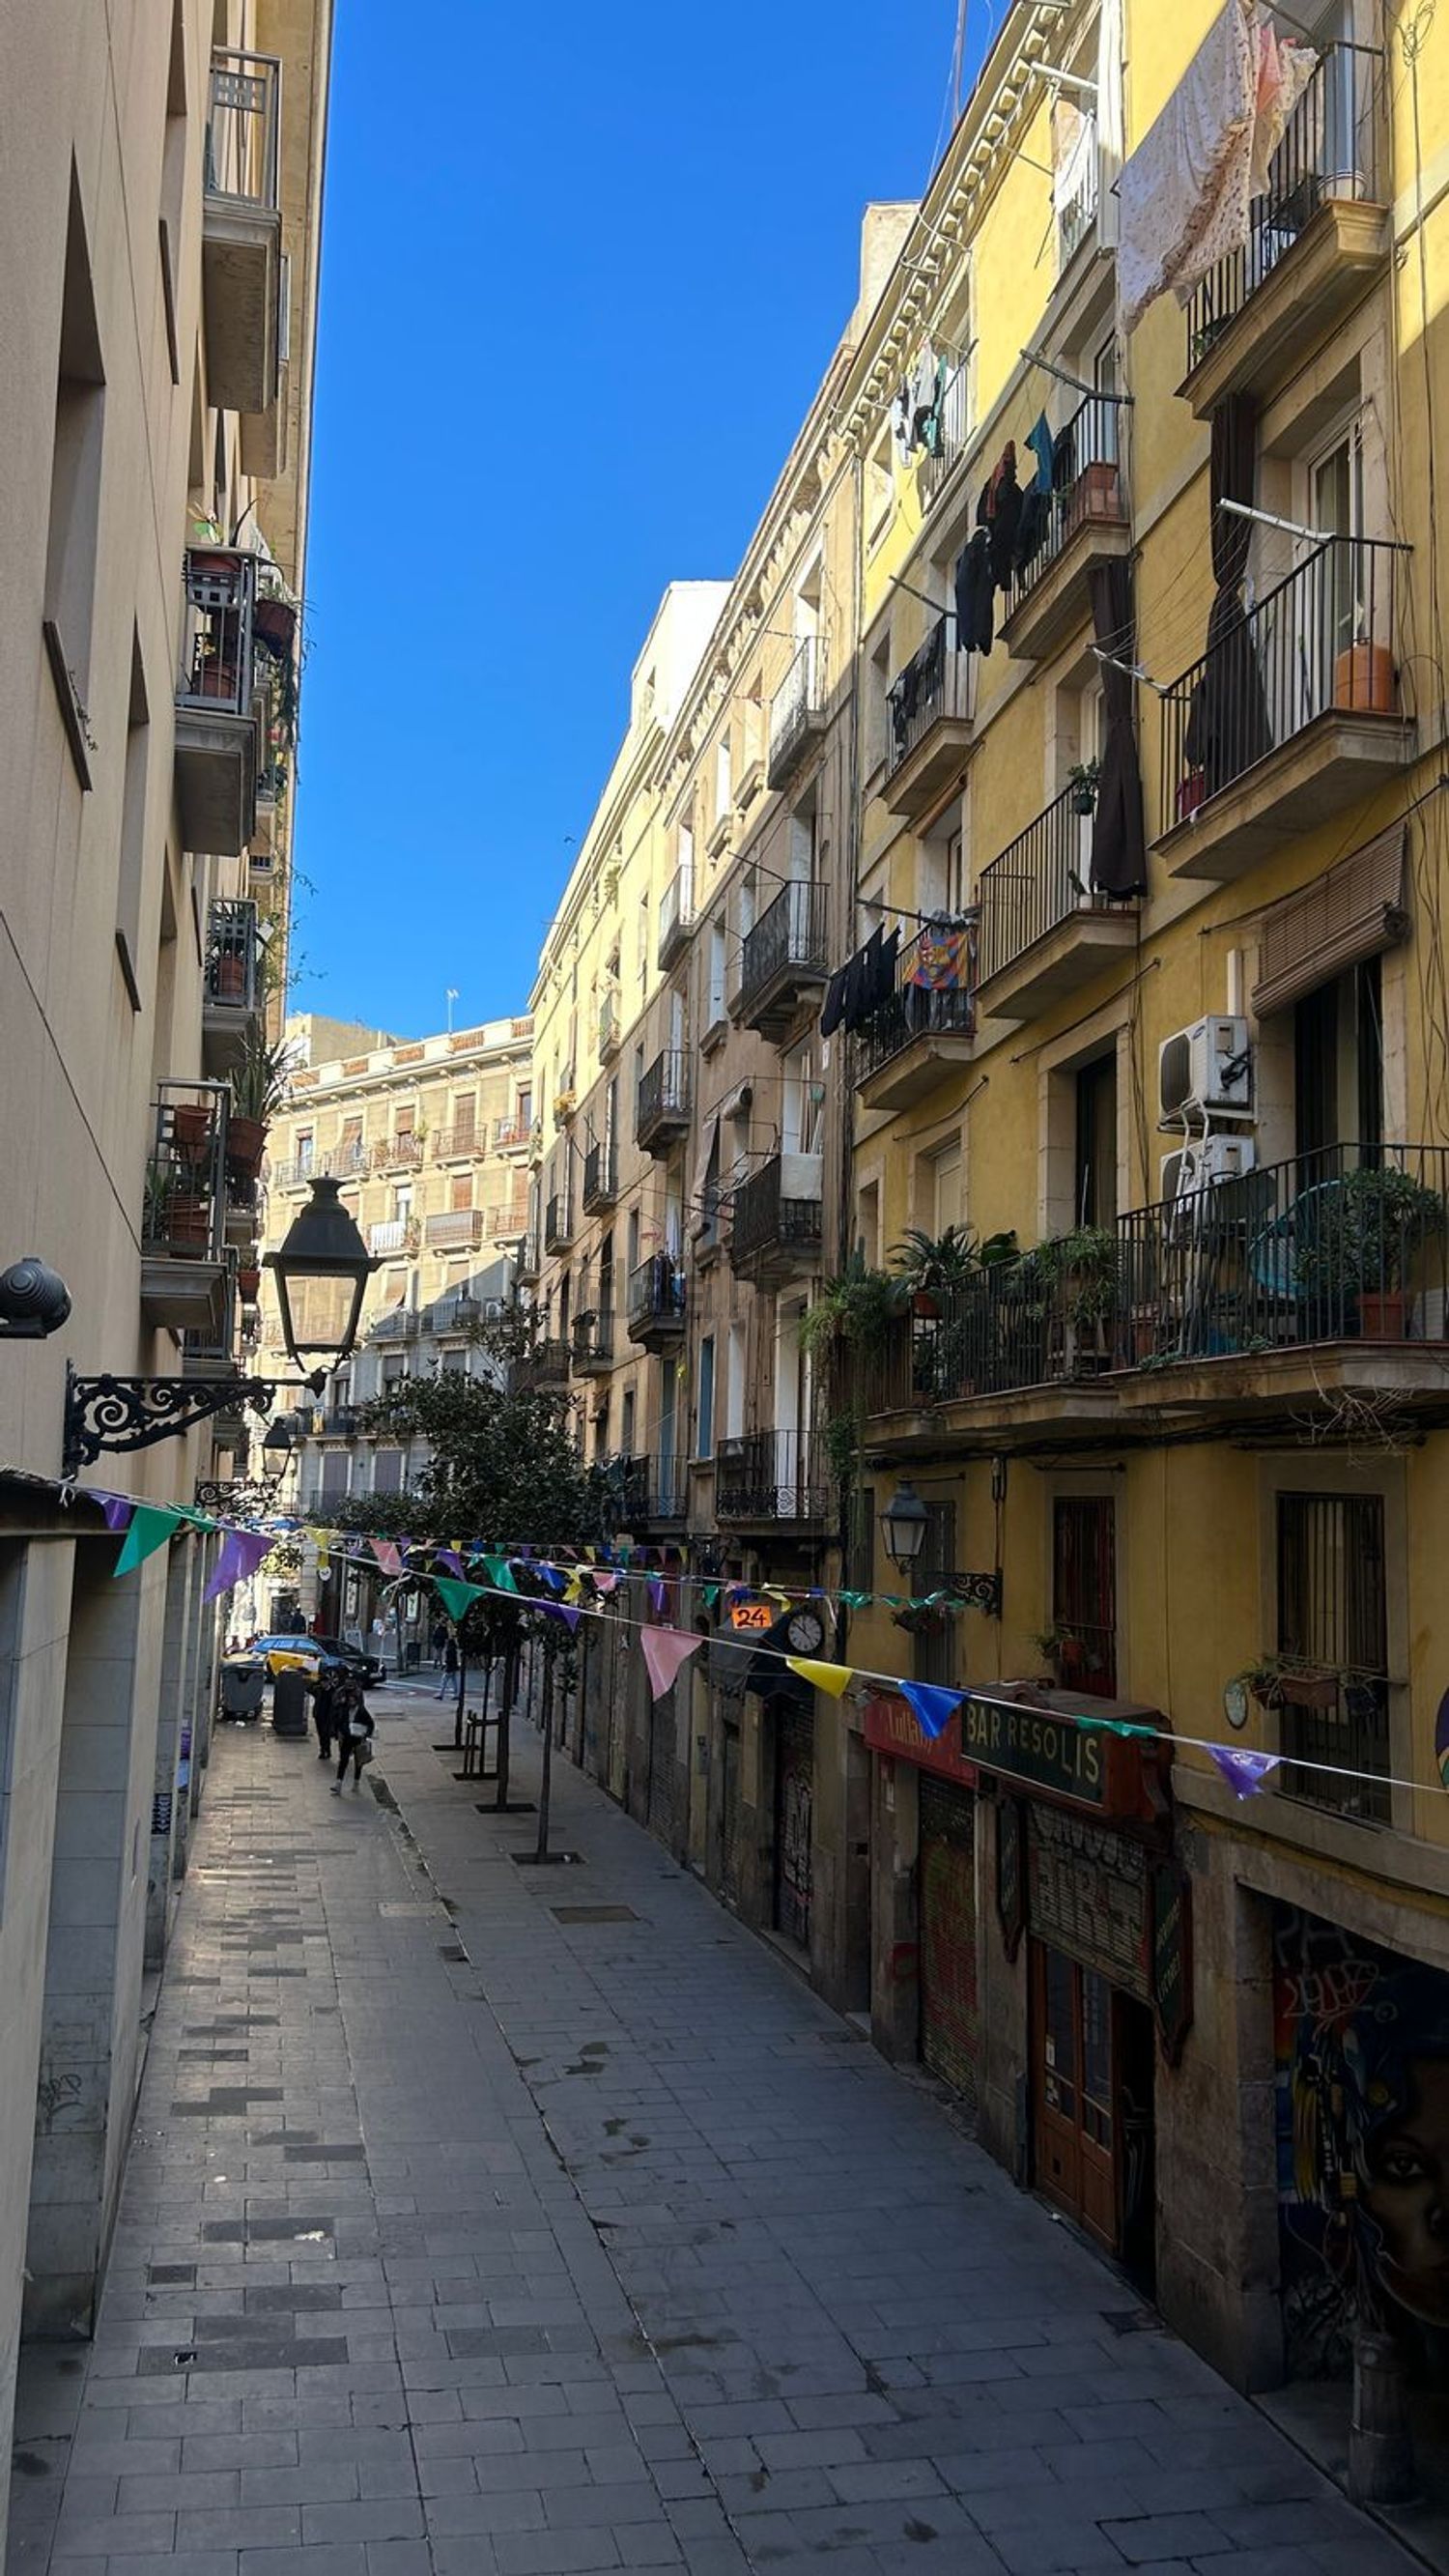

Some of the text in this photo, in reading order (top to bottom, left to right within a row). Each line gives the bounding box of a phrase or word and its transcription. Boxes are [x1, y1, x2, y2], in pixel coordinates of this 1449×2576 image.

[737, 1608, 766, 1627] 24
[966, 1703, 1099, 1784] BAR RESOLIS
